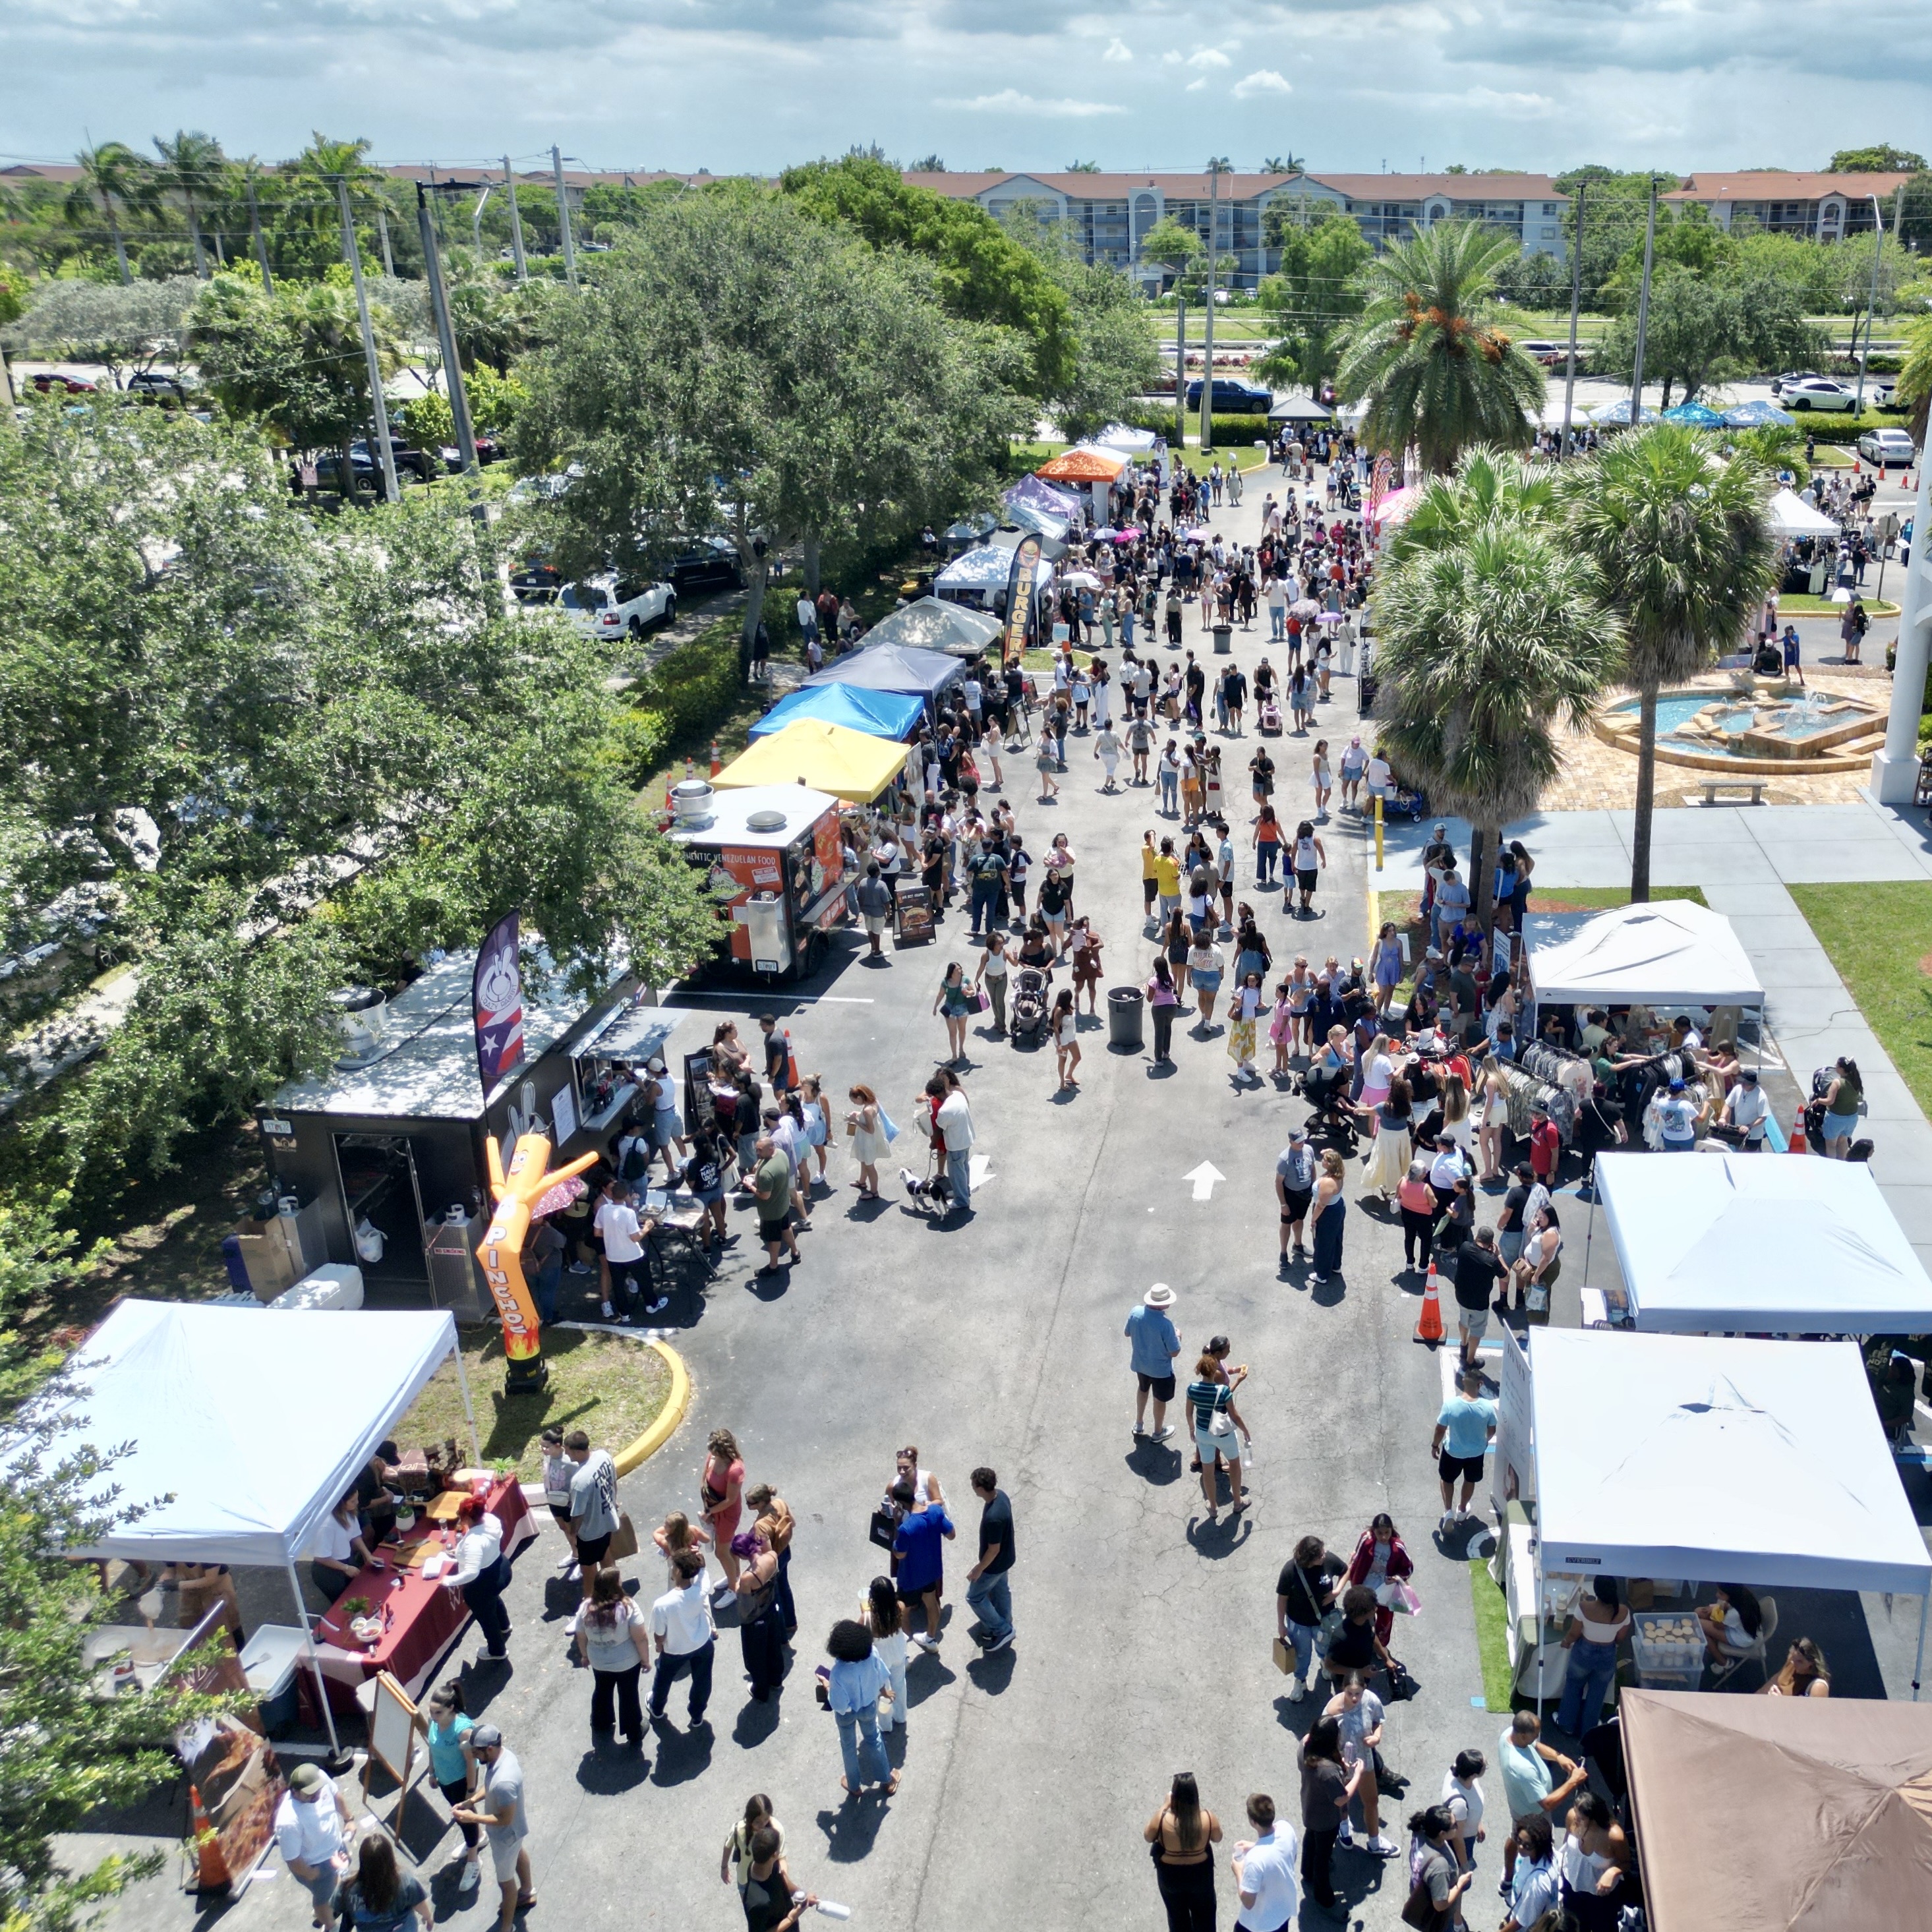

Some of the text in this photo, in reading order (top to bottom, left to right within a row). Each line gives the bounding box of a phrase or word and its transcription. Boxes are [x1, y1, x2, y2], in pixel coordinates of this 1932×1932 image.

[713, 854, 756, 864] VENEZUELAN
[758, 856, 776, 865] FOOD
[481, 983, 517, 1010] CRAZY RABBIT
